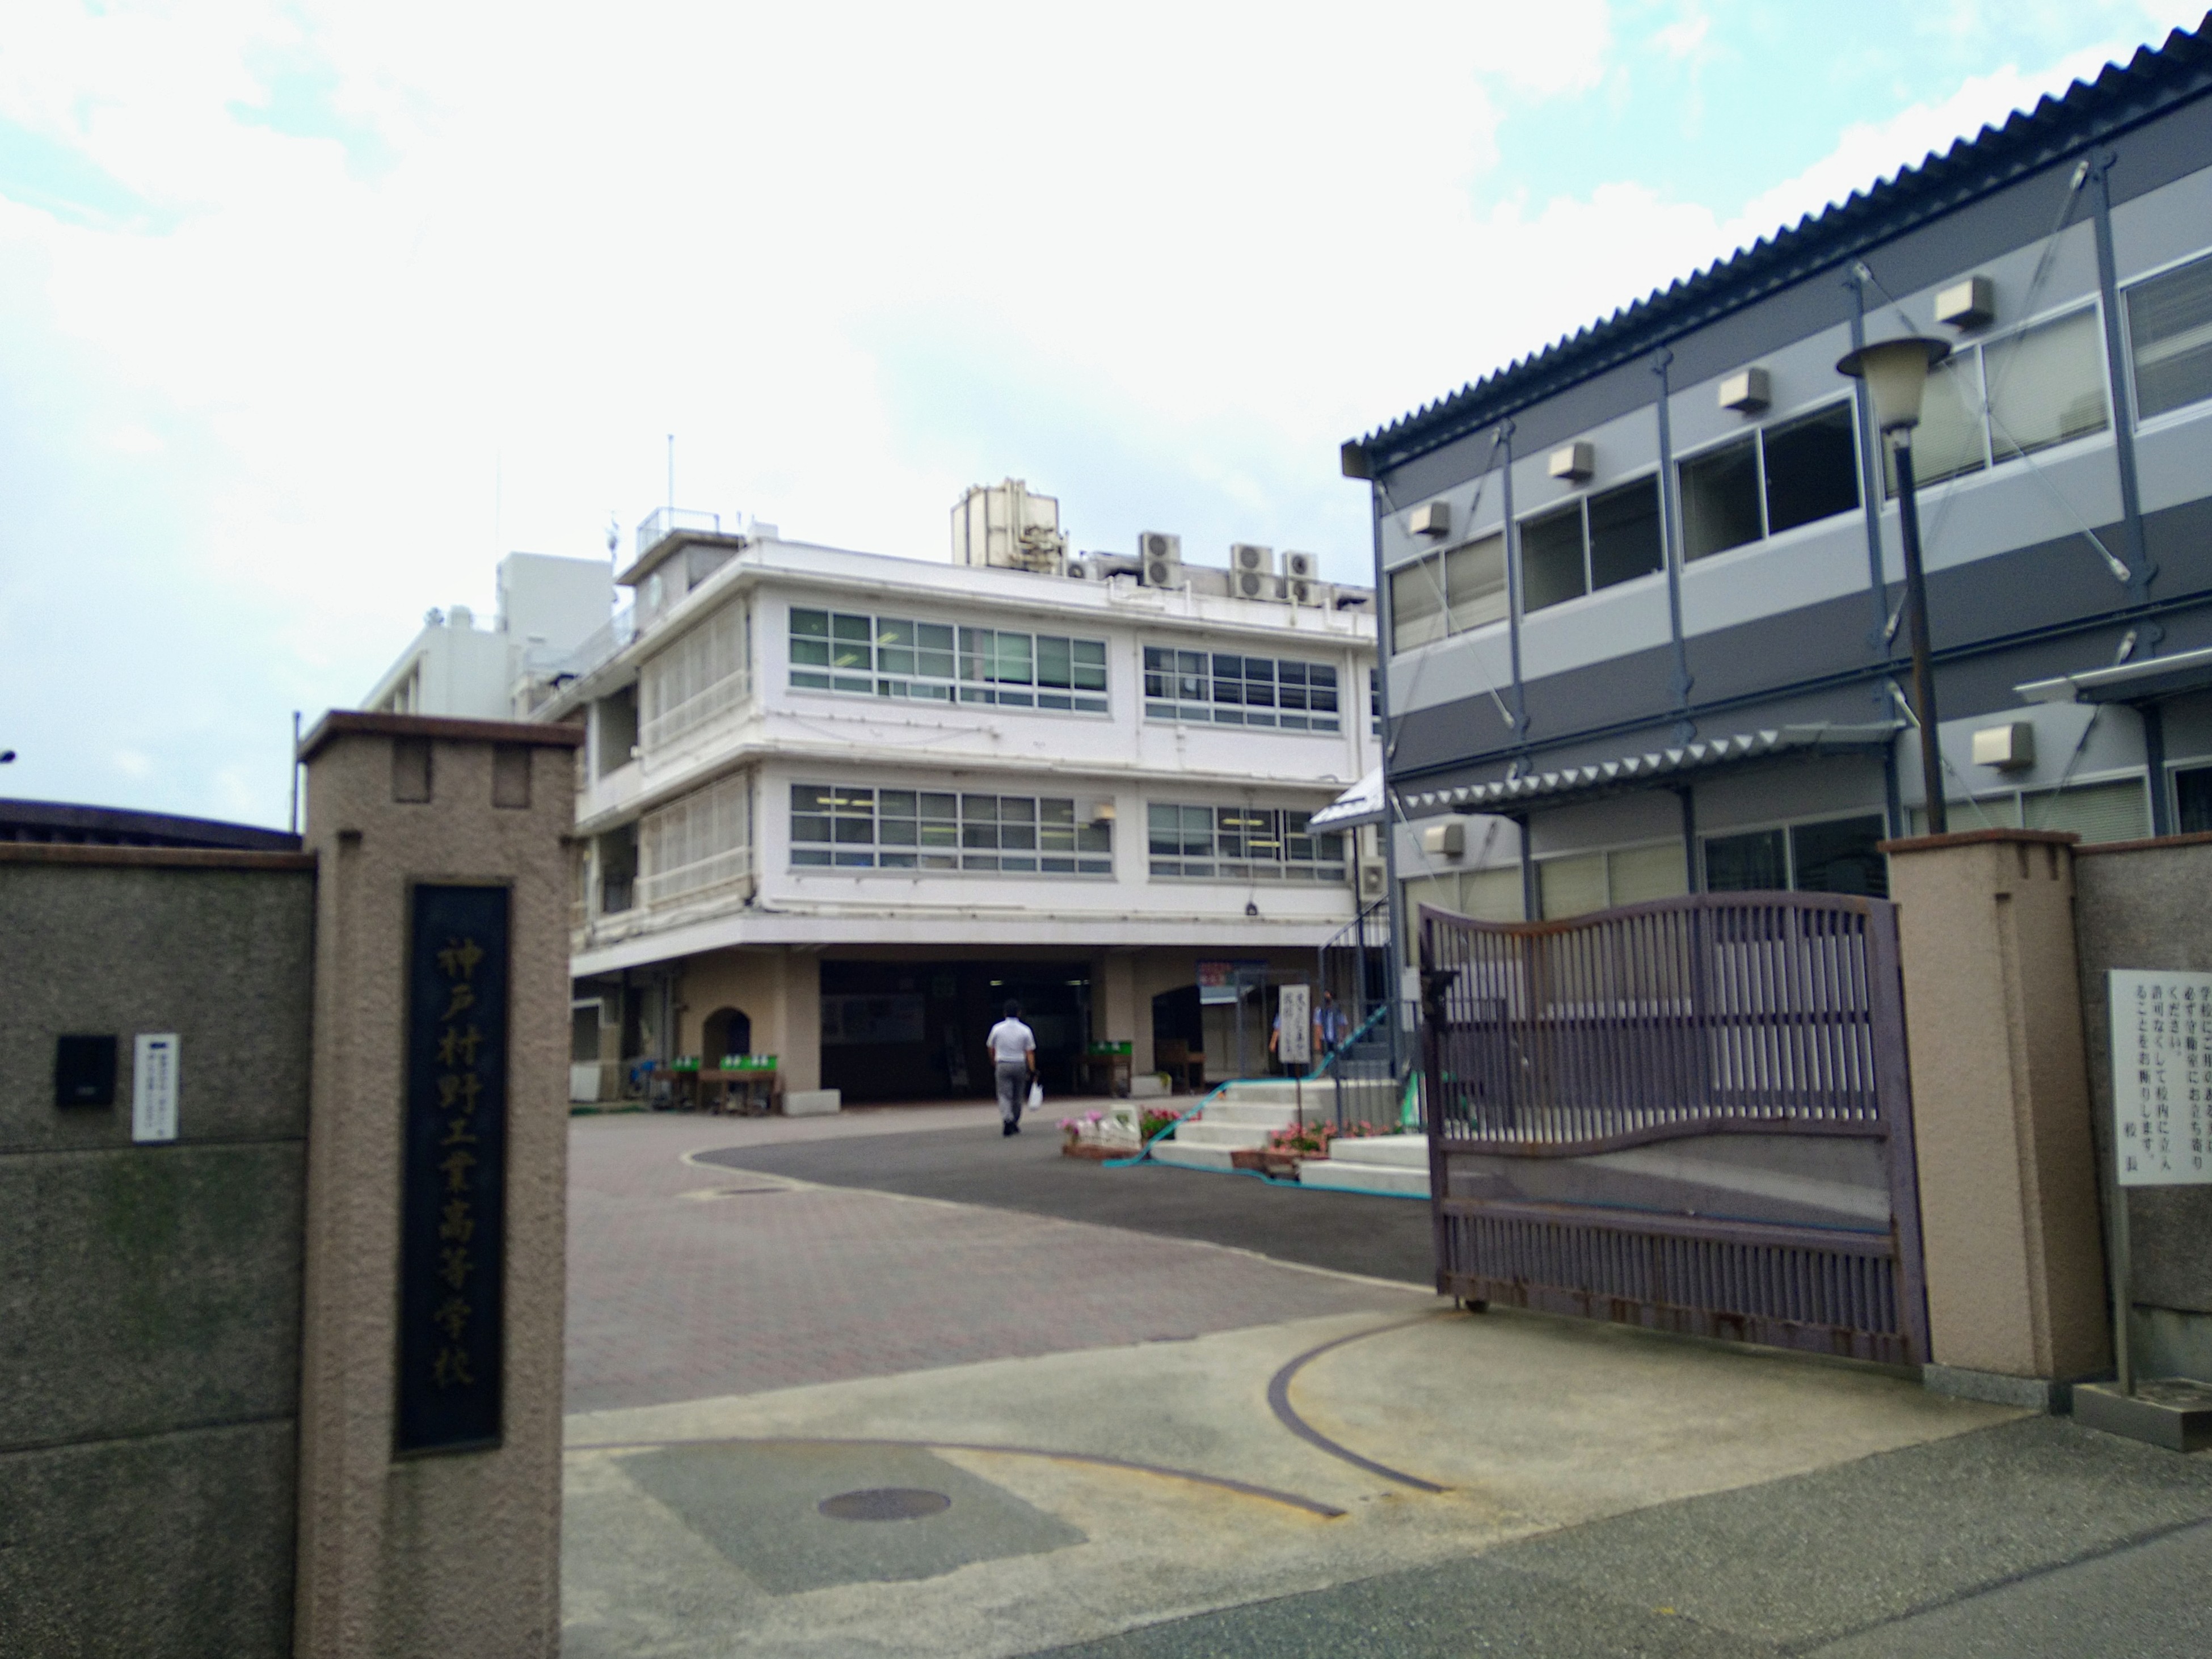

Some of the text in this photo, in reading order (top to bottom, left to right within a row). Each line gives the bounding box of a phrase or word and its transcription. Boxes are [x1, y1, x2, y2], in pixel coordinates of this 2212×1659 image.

[434, 937, 484, 1387] 神戸村野工業高等学校
